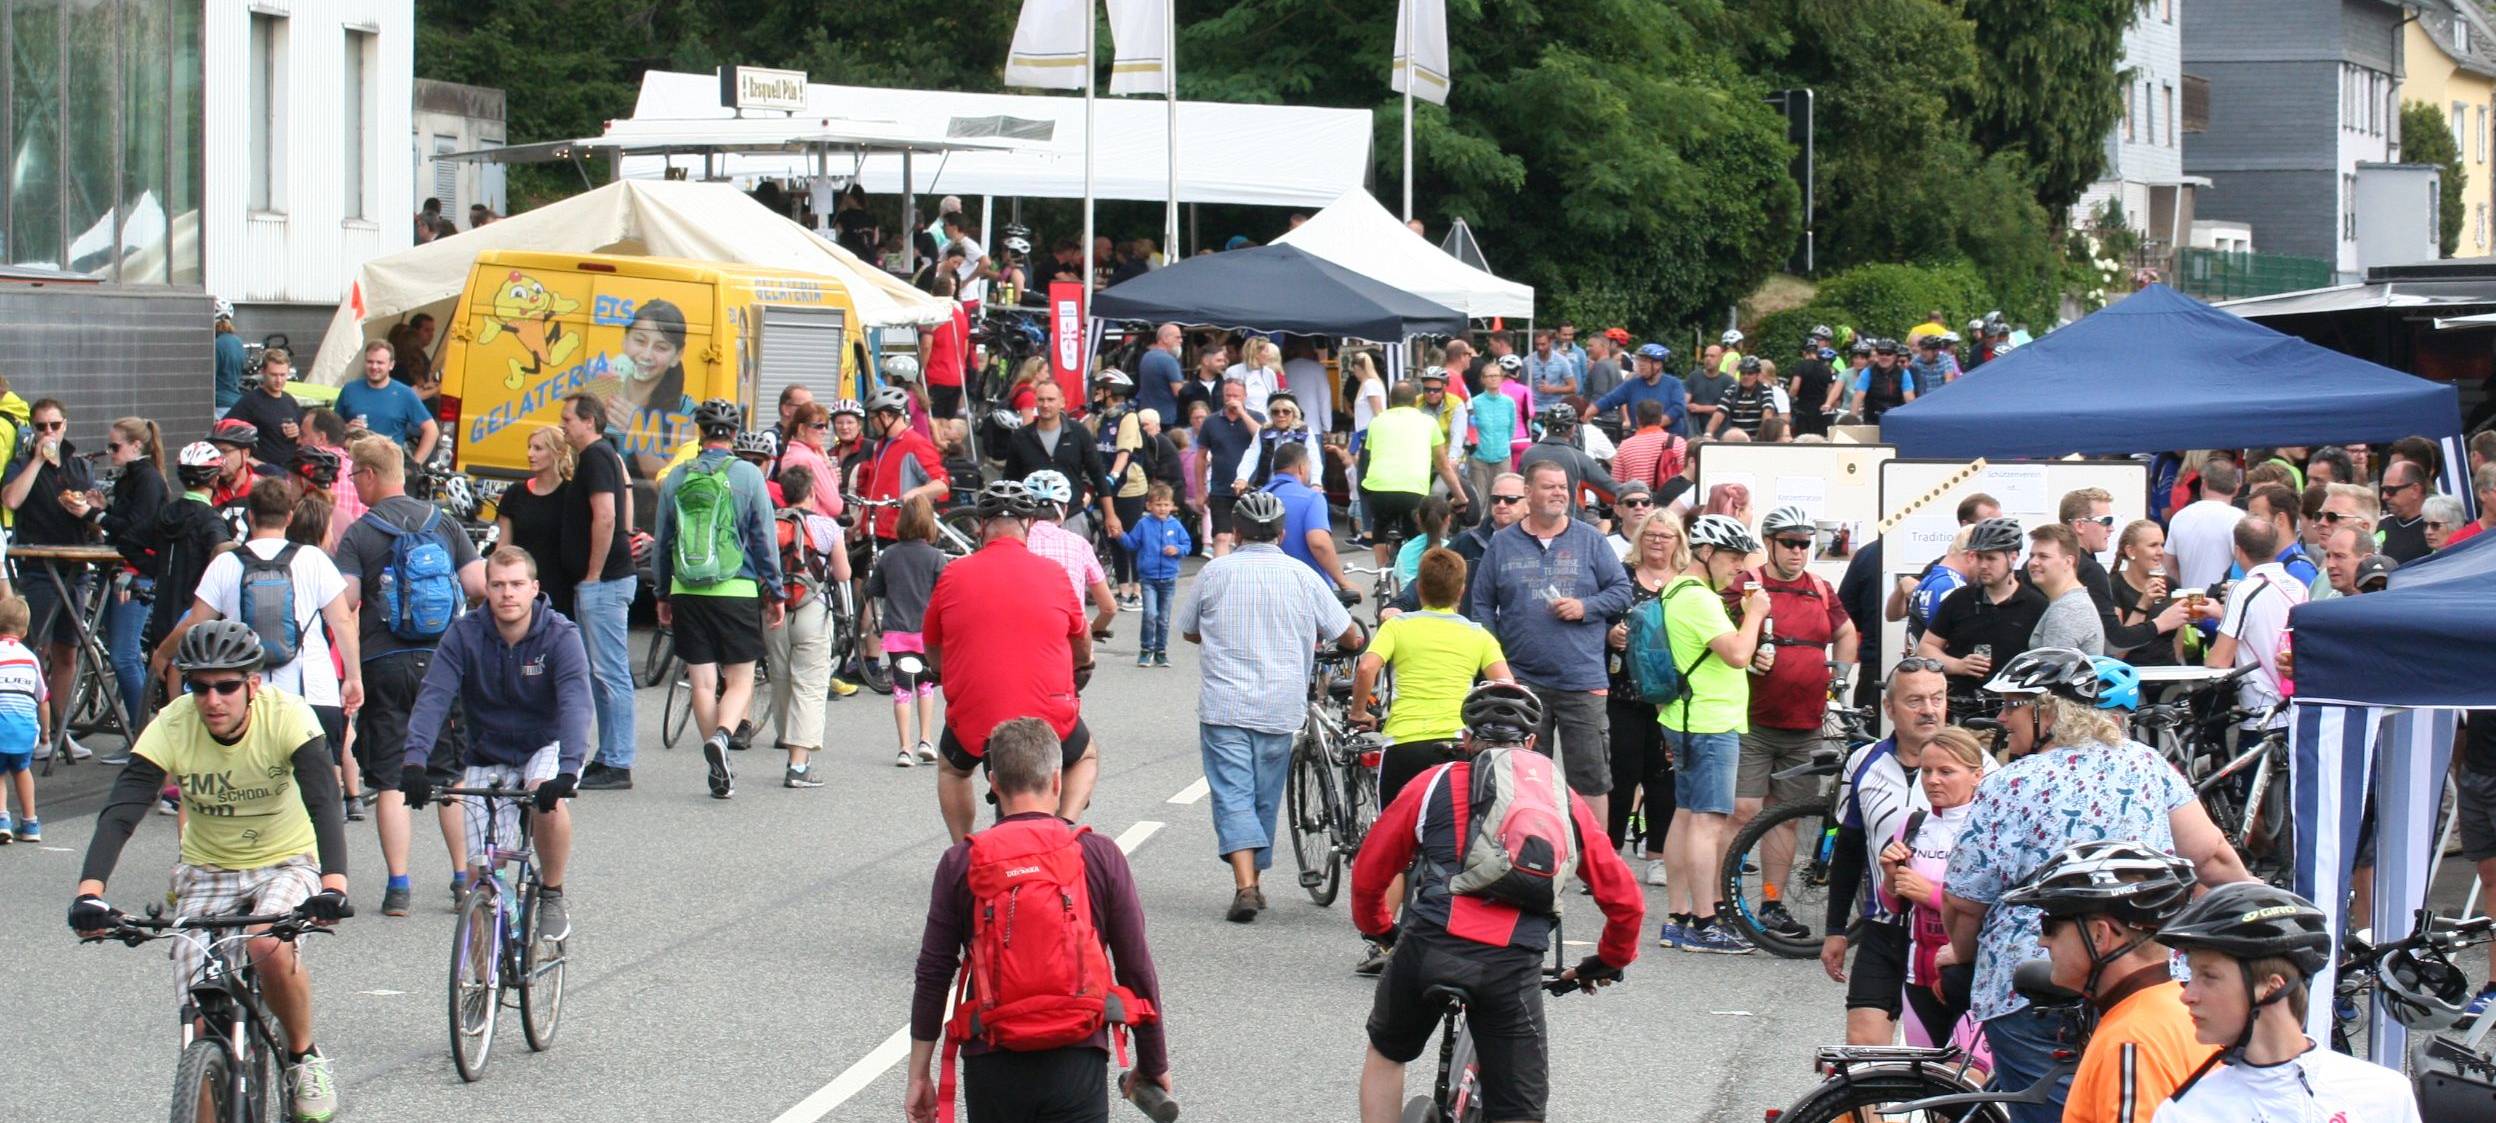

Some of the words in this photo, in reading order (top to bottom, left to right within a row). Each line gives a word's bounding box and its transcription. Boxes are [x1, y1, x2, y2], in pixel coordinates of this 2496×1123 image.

[593, 294, 636, 326] EIS
[469, 350, 609, 444] GELATERIA
[1912, 531, 1954, 543] Traditio
[218, 787, 273, 803] SCHOOL
[2110, 880, 2139, 897] uvex
[2259, 904, 2297, 918] GIRO
